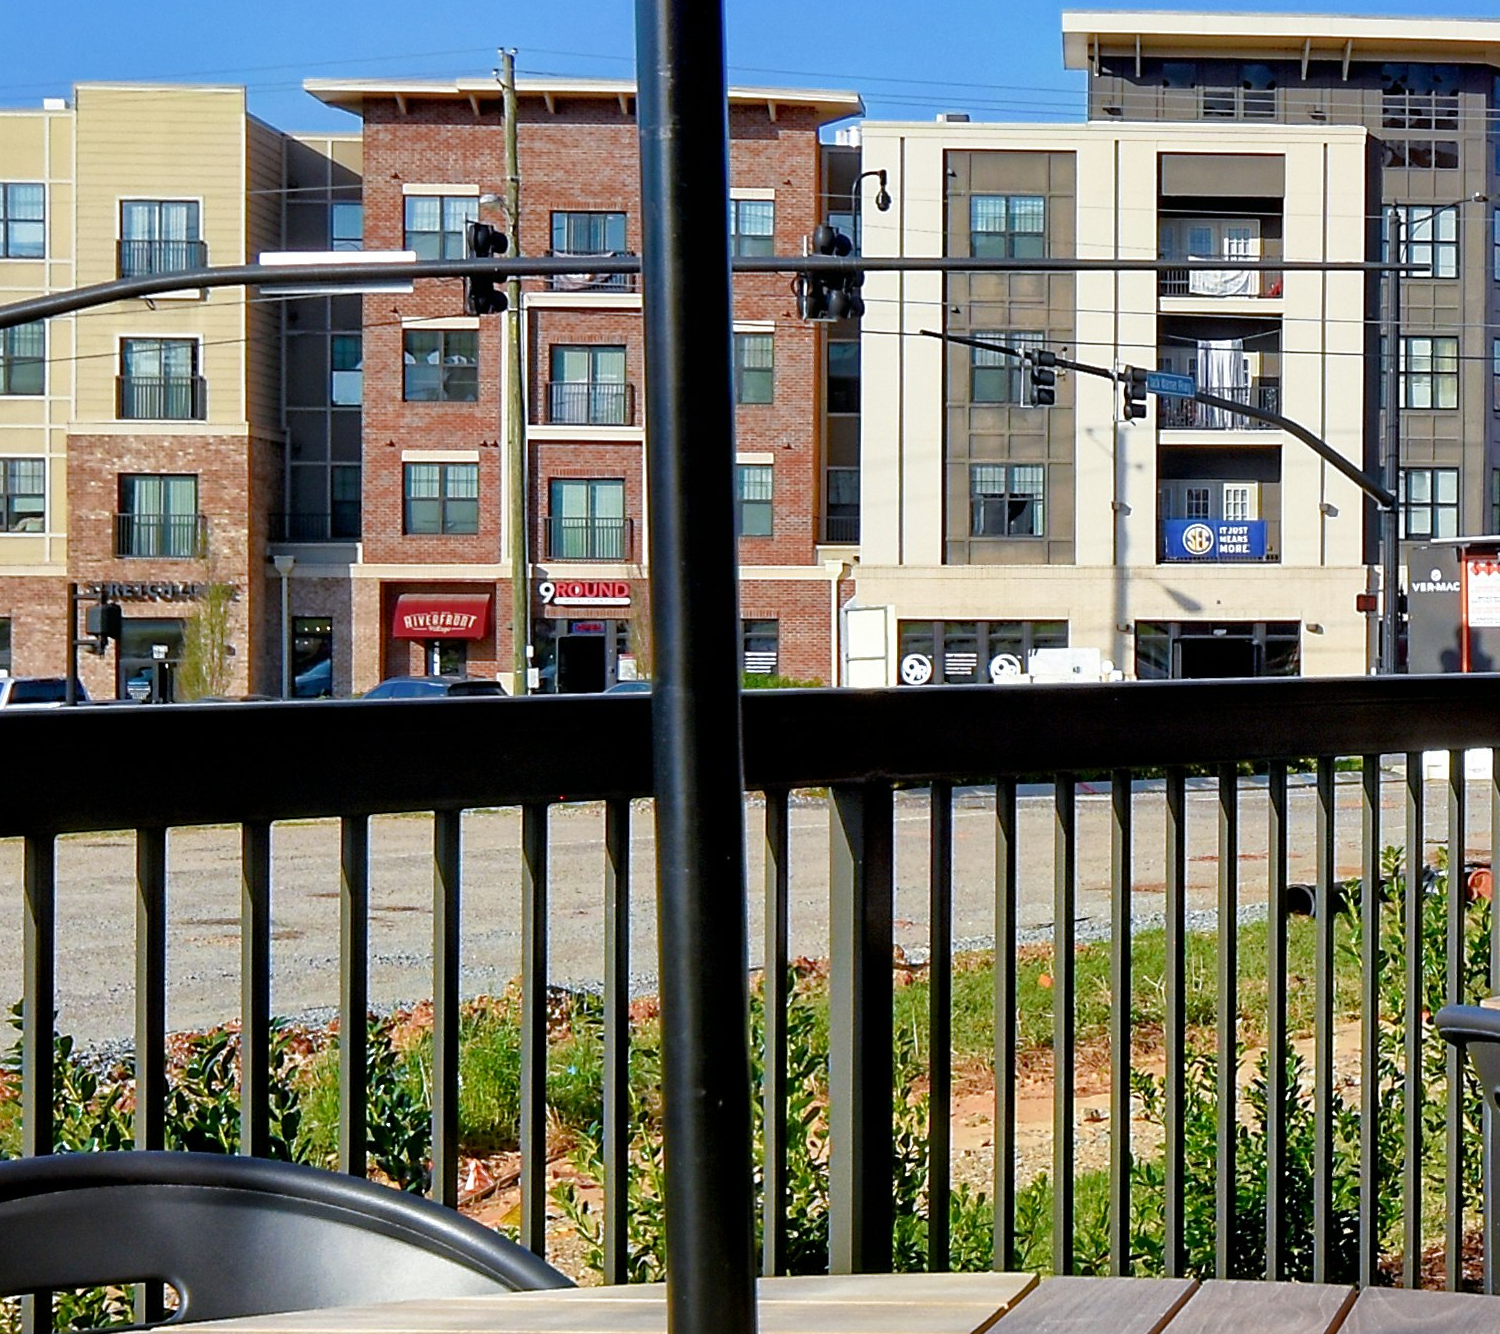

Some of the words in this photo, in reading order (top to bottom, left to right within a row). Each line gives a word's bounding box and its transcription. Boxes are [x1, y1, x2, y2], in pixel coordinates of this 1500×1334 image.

[1187, 528, 1210, 551] SEC
[1219, 535, 1248, 543] MEANS
[539, 581, 631, 604] 9ROUND
[1411, 581, 1460, 592] VER-MAC
[403, 613, 477, 629] RIVERFRONT
